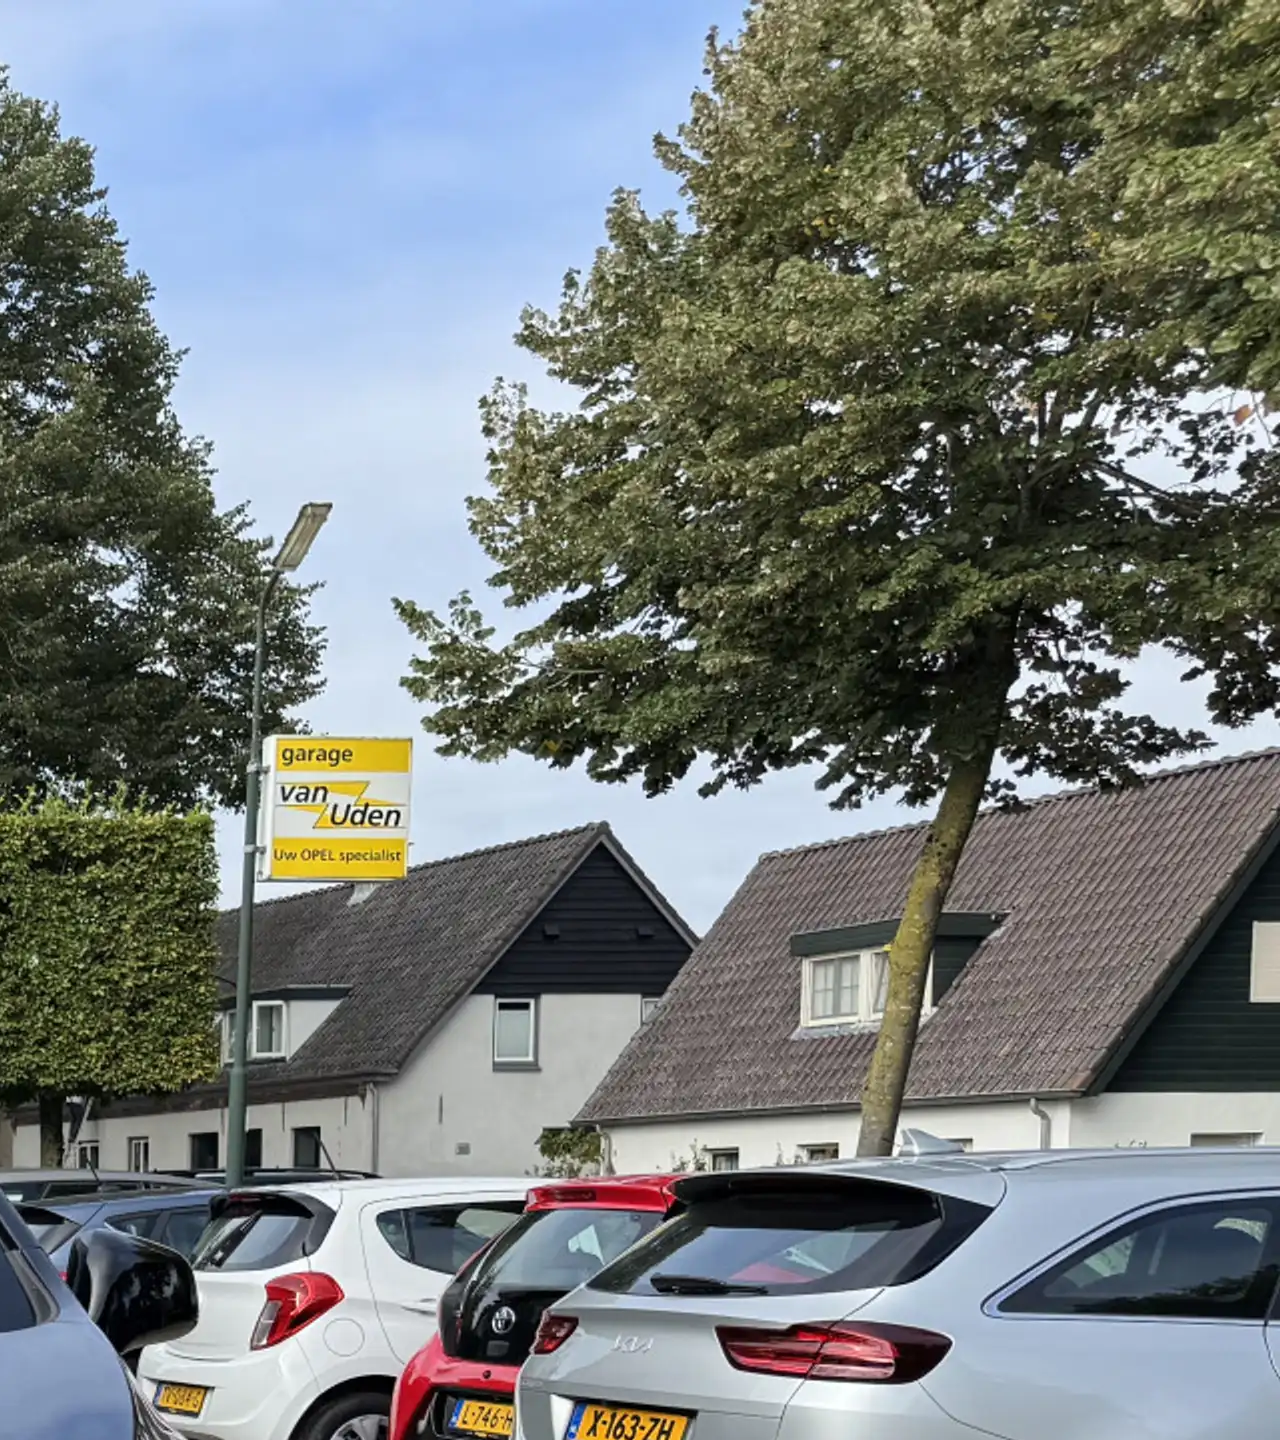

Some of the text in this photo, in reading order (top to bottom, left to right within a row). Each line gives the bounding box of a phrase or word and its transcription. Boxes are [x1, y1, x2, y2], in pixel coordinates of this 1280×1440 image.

[281, 748, 353, 767] garage
[280, 785, 328, 803] van
[330, 802, 401, 827] Uden
[273, 848, 401, 864] Uw OPEL specialist
